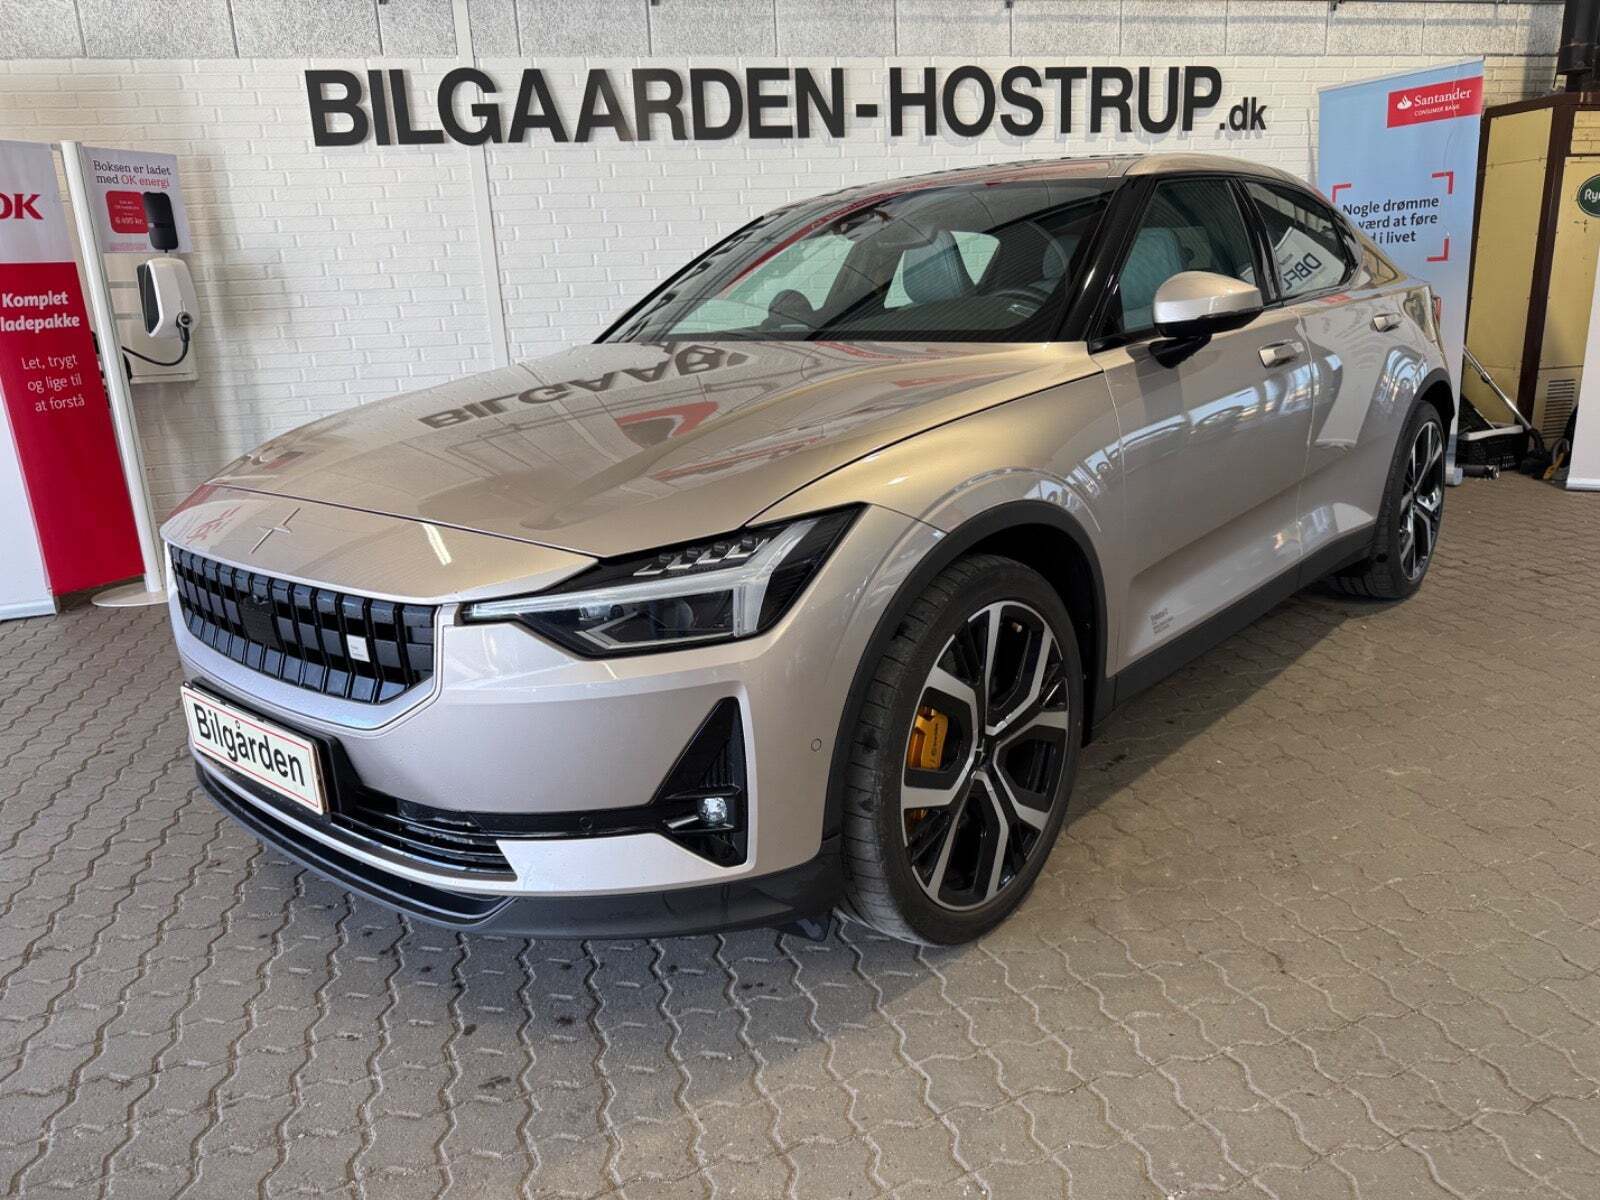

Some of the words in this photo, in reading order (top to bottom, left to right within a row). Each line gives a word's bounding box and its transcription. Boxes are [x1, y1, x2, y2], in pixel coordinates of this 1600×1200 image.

[1414, 87, 1472, 107] Santander
[1414, 107, 1443, 117] CONSUMER
[1445, 104, 1460, 112] BANK
[93, 160, 131, 174] Boksen
[133, 167, 144, 175] er
[146, 164, 172, 176] ladet
[96, 174, 119, 185] med
[121, 175, 137, 185] OK
[139, 178, 170, 190] energi
[1584, 188, 1600, 204] Ry
[1343, 201, 1380, 217] Nogle
[1383, 197, 1439, 213] drømme
[1359, 216, 1390, 230] værd
[1393, 216, 1407, 227] at
[1410, 212, 1438, 226] føre
[1379, 232, 1384, 244] i
[1386, 230, 1417, 244] livet
[2, 290, 69, 310] Komplet
[0, 312, 80, 334] ladepakke
[48, 354, 78, 370] trygt
[27, 380, 45, 394] og
[45, 376, 68, 392] lige
[70, 373, 82, 386] til
[35, 401, 48, 412] at
[49, 393, 86, 410] forstå
[193, 702, 305, 786] Bilgården
